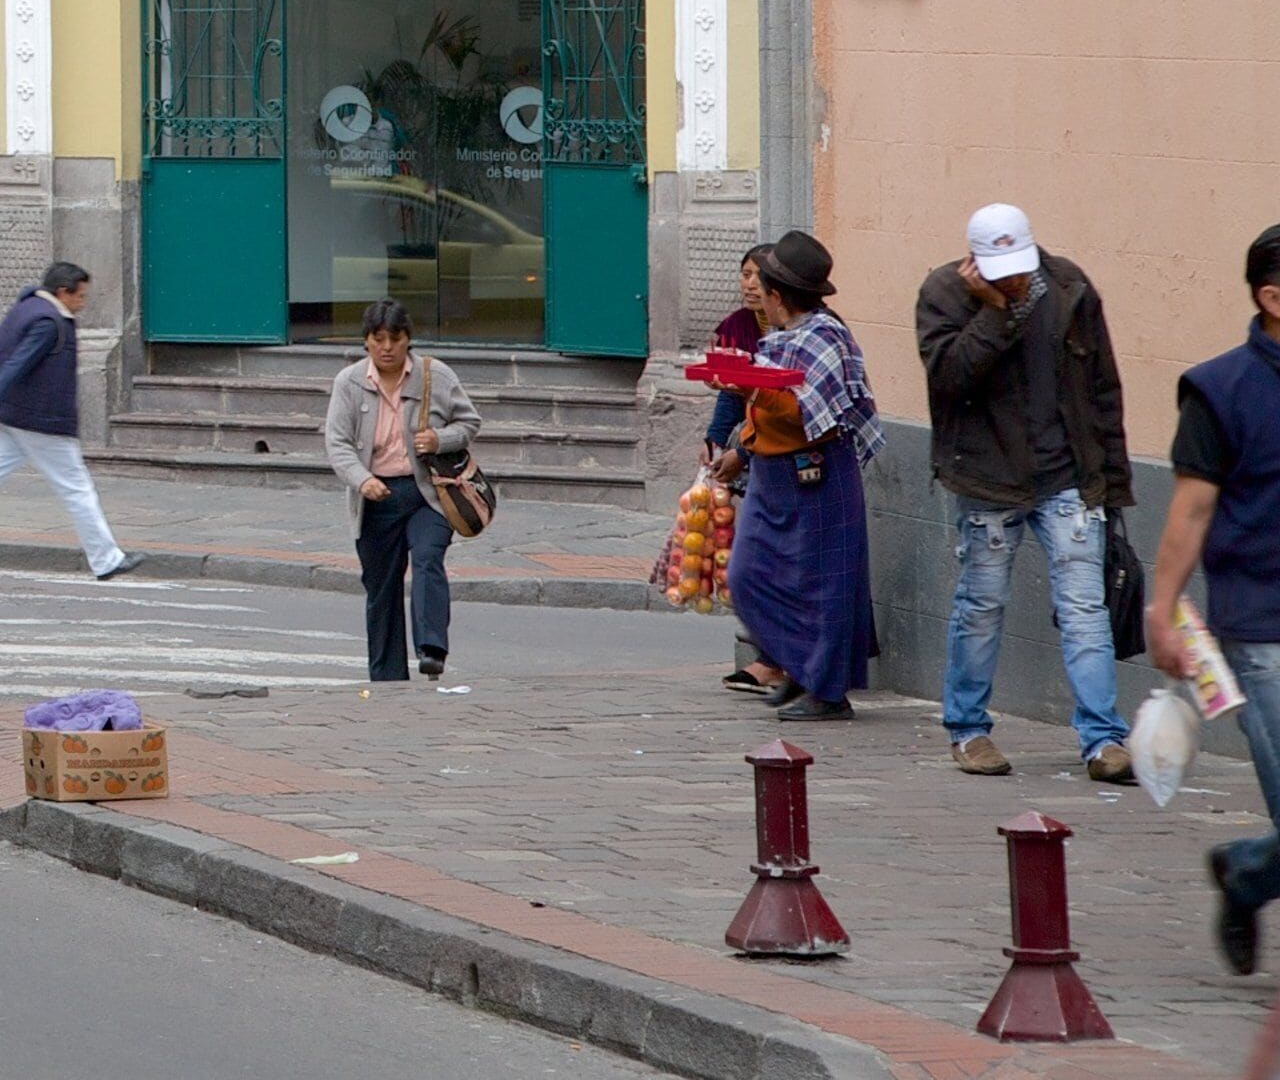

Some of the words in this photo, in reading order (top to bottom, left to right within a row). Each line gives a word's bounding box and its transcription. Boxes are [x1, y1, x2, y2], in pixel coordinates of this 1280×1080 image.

[340, 145, 417, 160] Coordinador
[456, 147, 517, 161] Ministerio
[324, 163, 393, 179] Seguridad
[486, 166, 502, 178] de
